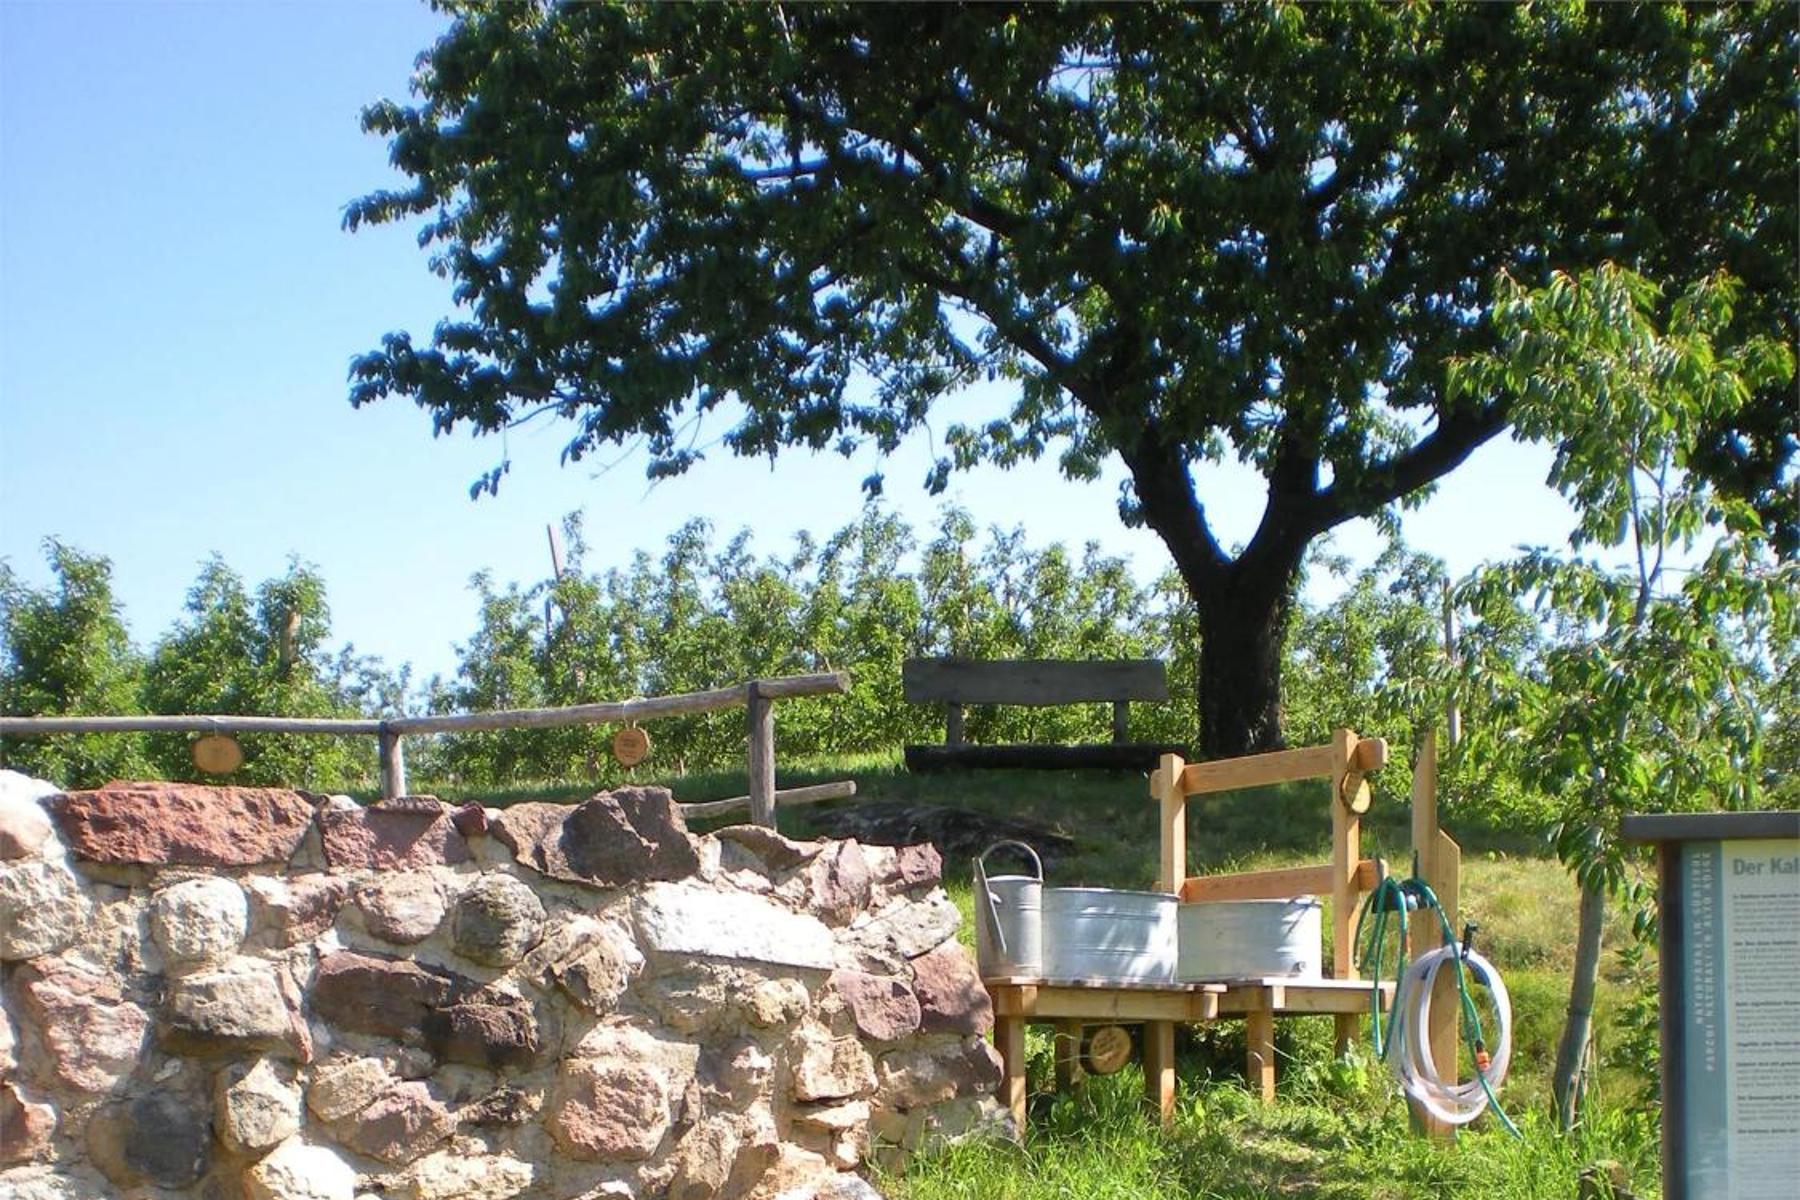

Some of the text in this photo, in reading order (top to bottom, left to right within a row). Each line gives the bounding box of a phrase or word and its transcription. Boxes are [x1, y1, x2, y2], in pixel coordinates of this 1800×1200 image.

[1733, 859, 1764, 875] Der
[1703, 954, 1714, 1017] NATURALI
[1704, 1024, 1715, 1073] PARCHI
